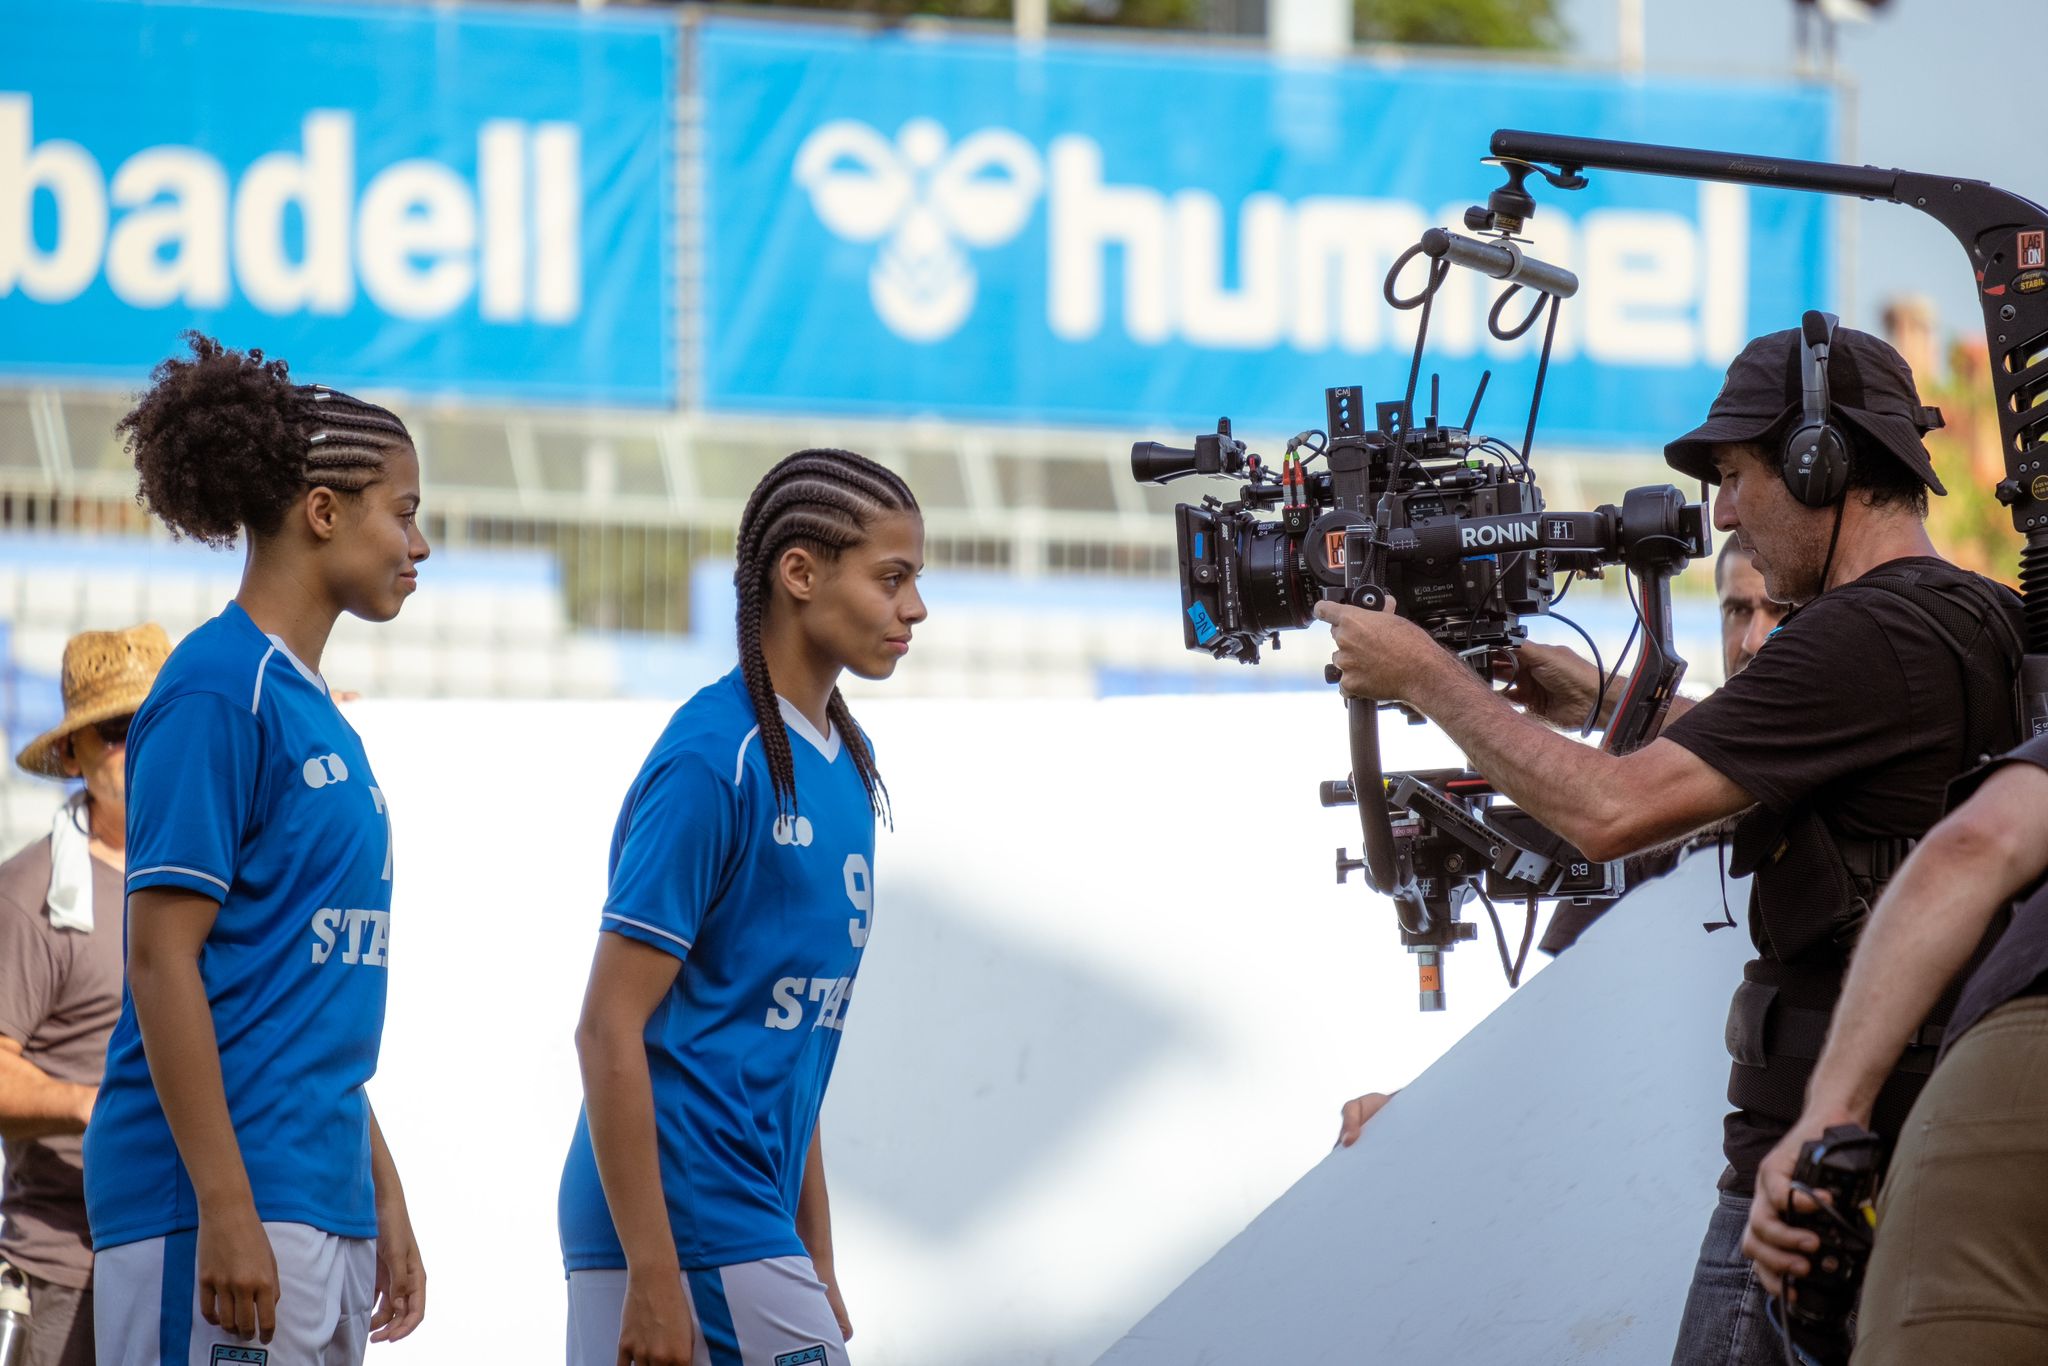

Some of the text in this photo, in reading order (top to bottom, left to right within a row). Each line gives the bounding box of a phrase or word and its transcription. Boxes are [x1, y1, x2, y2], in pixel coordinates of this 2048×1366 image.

[1046, 132, 1750, 367] hummel
[2020, 278, 2045, 290] STABIL
[1461, 520, 1538, 548] RONIN
[1553, 521, 1568, 539] #1
[1330, 535, 1345, 550] LA
[1570, 863, 1589, 876] B3
[843, 853, 872, 948] 9
